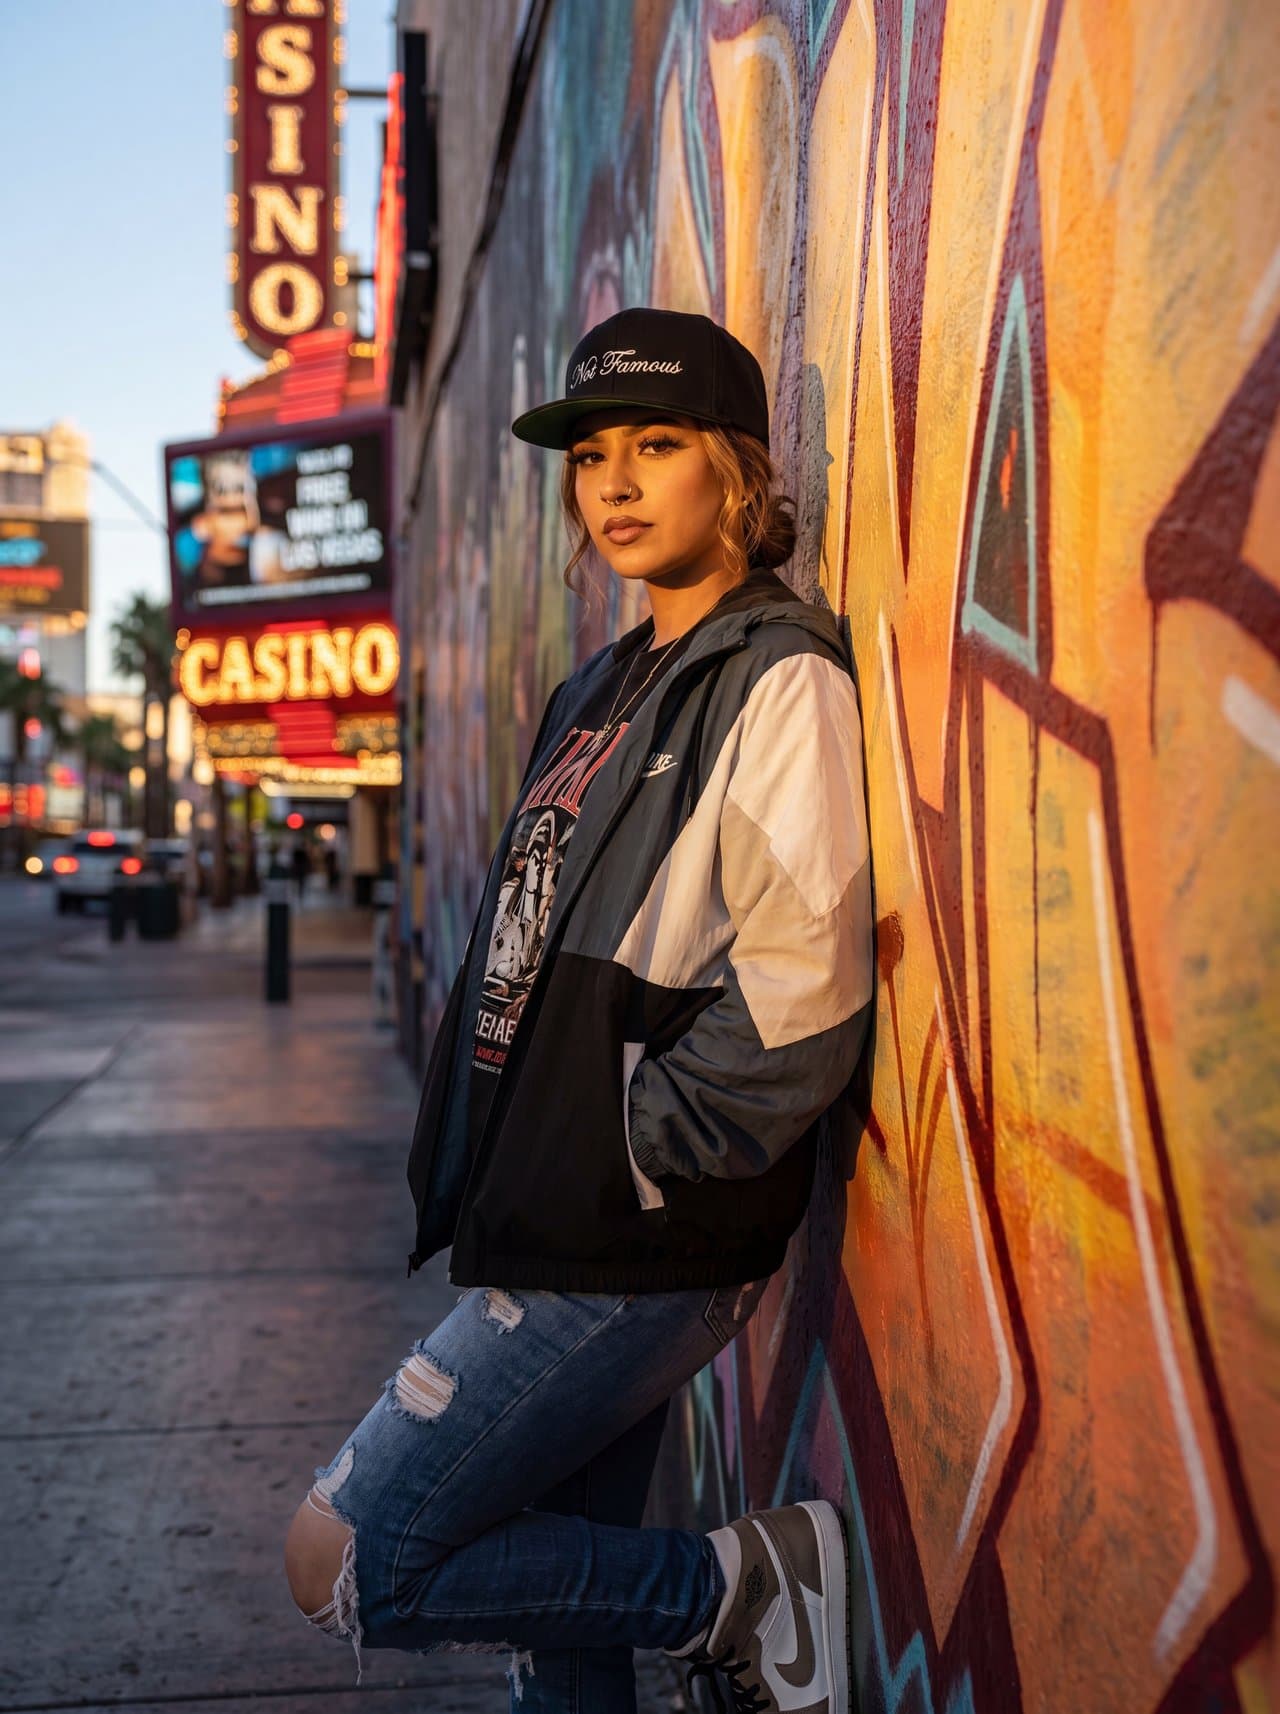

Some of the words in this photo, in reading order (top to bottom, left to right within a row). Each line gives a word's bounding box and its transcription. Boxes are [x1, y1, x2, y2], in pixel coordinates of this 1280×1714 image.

[246, 0, 326, 337] SINO
[570, 355, 598, 390] Not
[599, 349, 684, 375] Famous
[180, 622, 401, 707] CASINO
